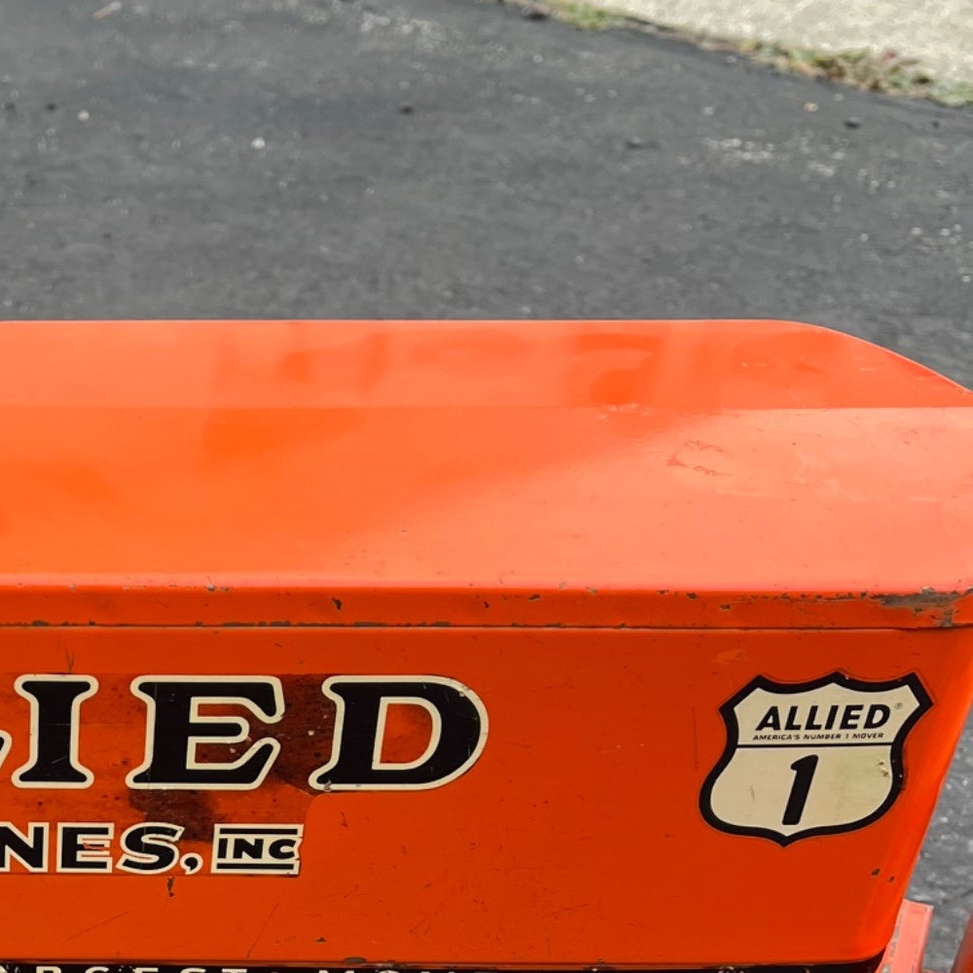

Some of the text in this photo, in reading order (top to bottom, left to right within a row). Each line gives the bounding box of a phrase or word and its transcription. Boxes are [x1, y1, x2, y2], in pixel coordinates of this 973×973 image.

[755, 704, 891, 731] ALLIED
[803, 733, 841, 741] NUMBER
[852, 732, 884, 740] MOVER
[782, 754, 819, 826] 1
[215, 833, 302, 863] INC
